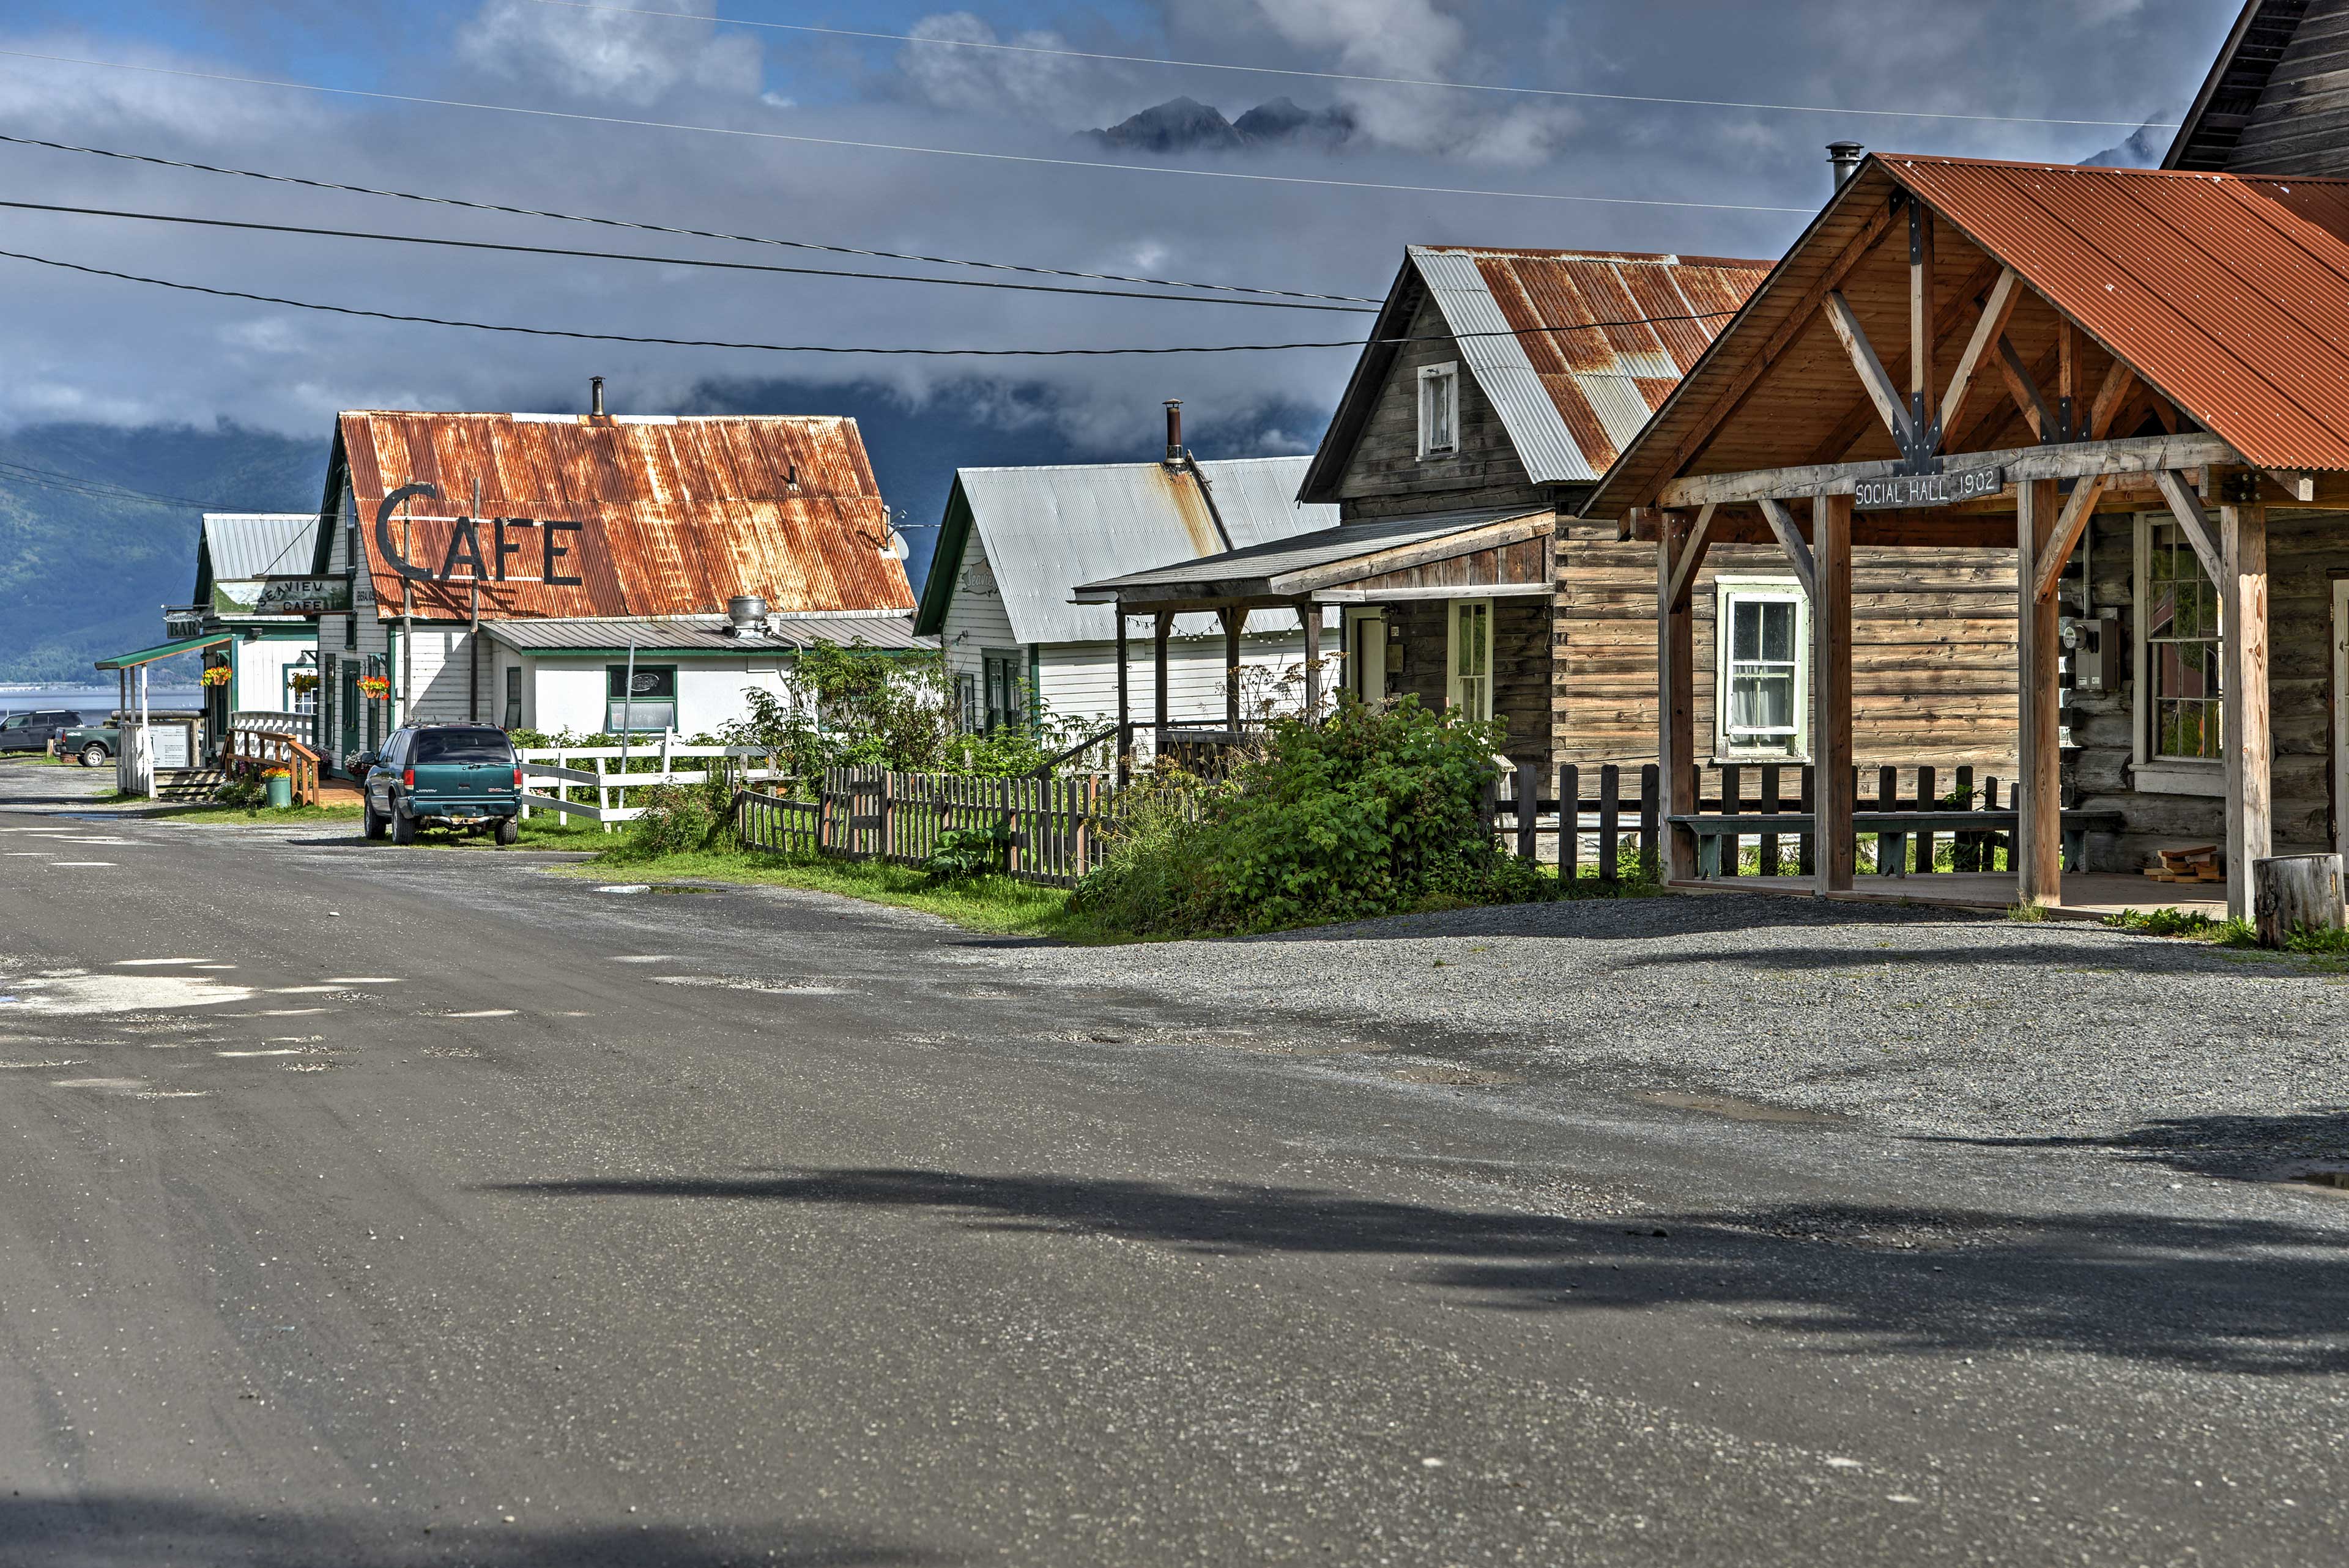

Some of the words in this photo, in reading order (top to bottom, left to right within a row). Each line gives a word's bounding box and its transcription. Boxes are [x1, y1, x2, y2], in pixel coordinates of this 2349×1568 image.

[1855, 484, 1903, 505] SOCIAL
[1909, 480, 1948, 501] HALL
[1960, 470, 1995, 494] 1902
[375, 481, 583, 586] CAFE
[257, 581, 322, 607] SEAVIEW
[283, 601, 322, 611] CAFE
[169, 623, 196, 637] BAR
